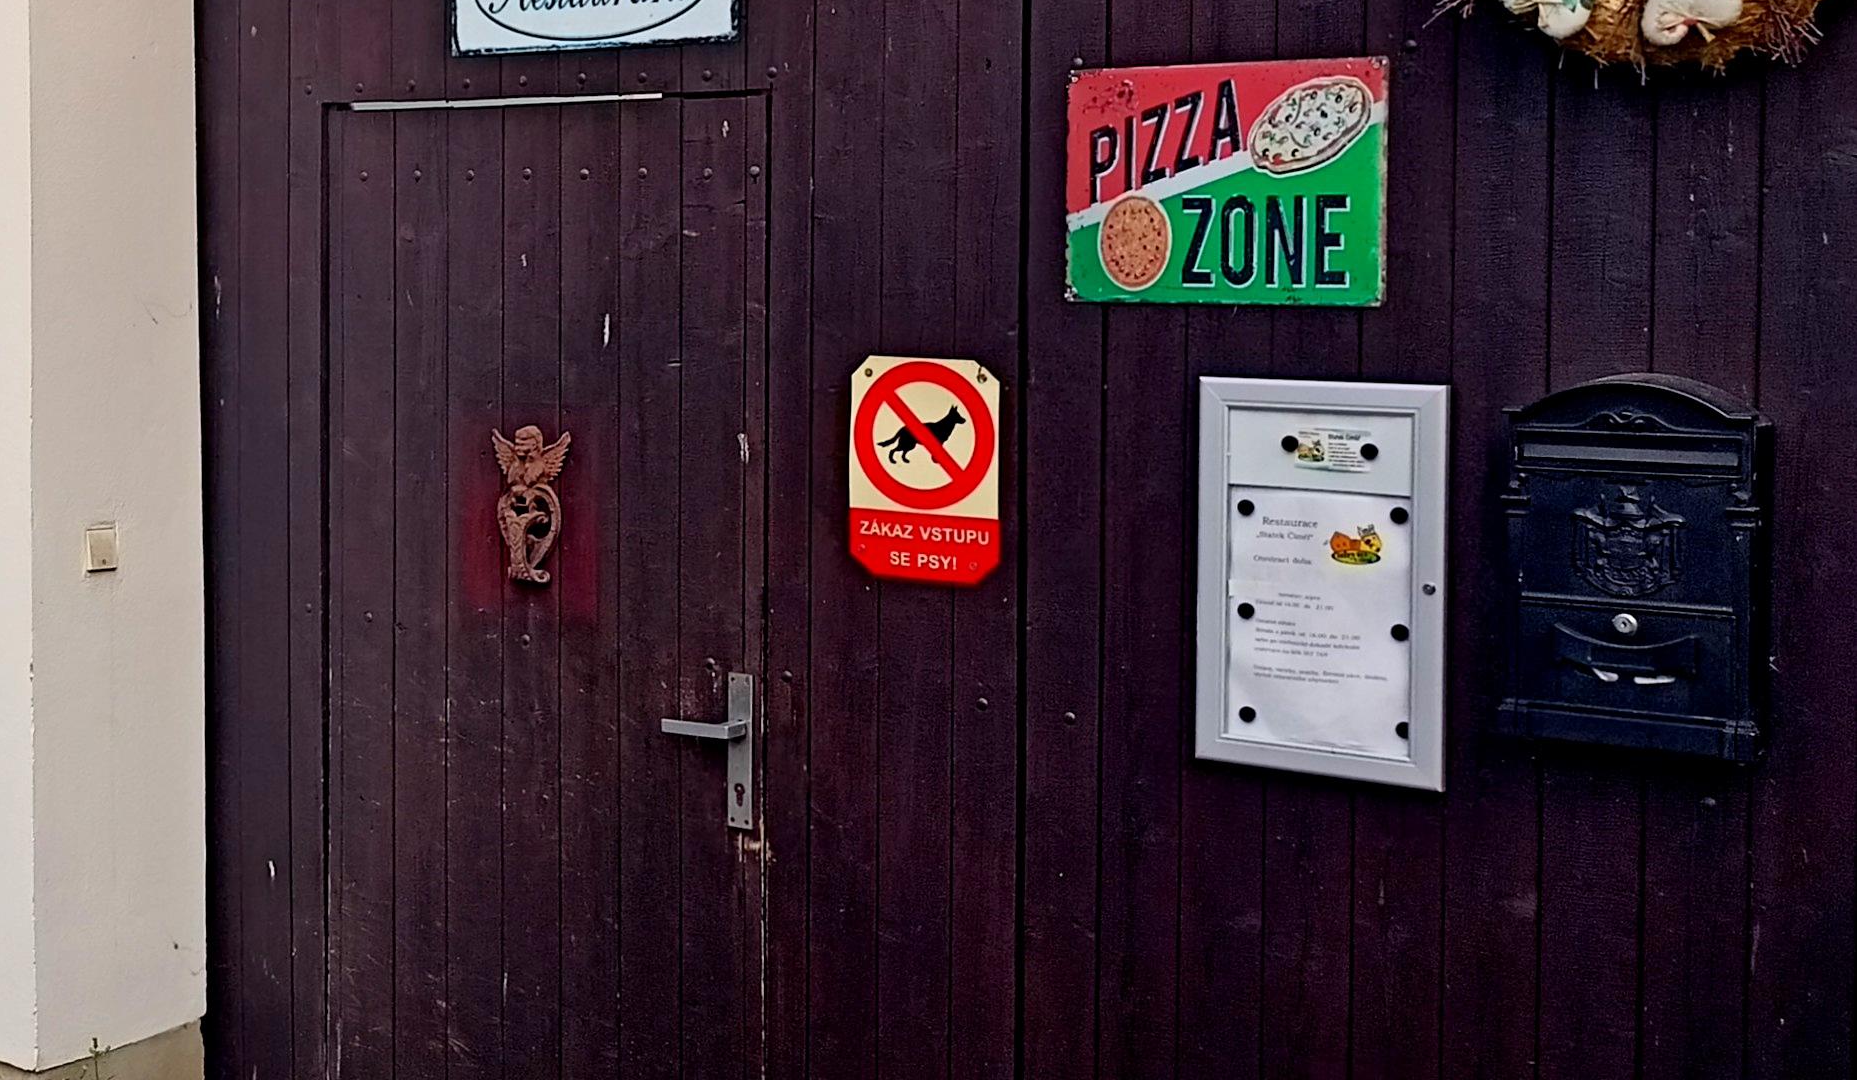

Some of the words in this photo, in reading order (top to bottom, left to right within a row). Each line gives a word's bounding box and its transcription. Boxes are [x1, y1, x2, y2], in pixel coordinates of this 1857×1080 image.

[1089, 78, 1246, 205] PIZZA
[1181, 194, 1351, 288] ZONE
[859, 518, 914, 539] ZÁKAZ
[919, 526, 990, 545] VSTUPU
[890, 551, 911, 566] SE
[917, 553, 957, 571] PSY!
